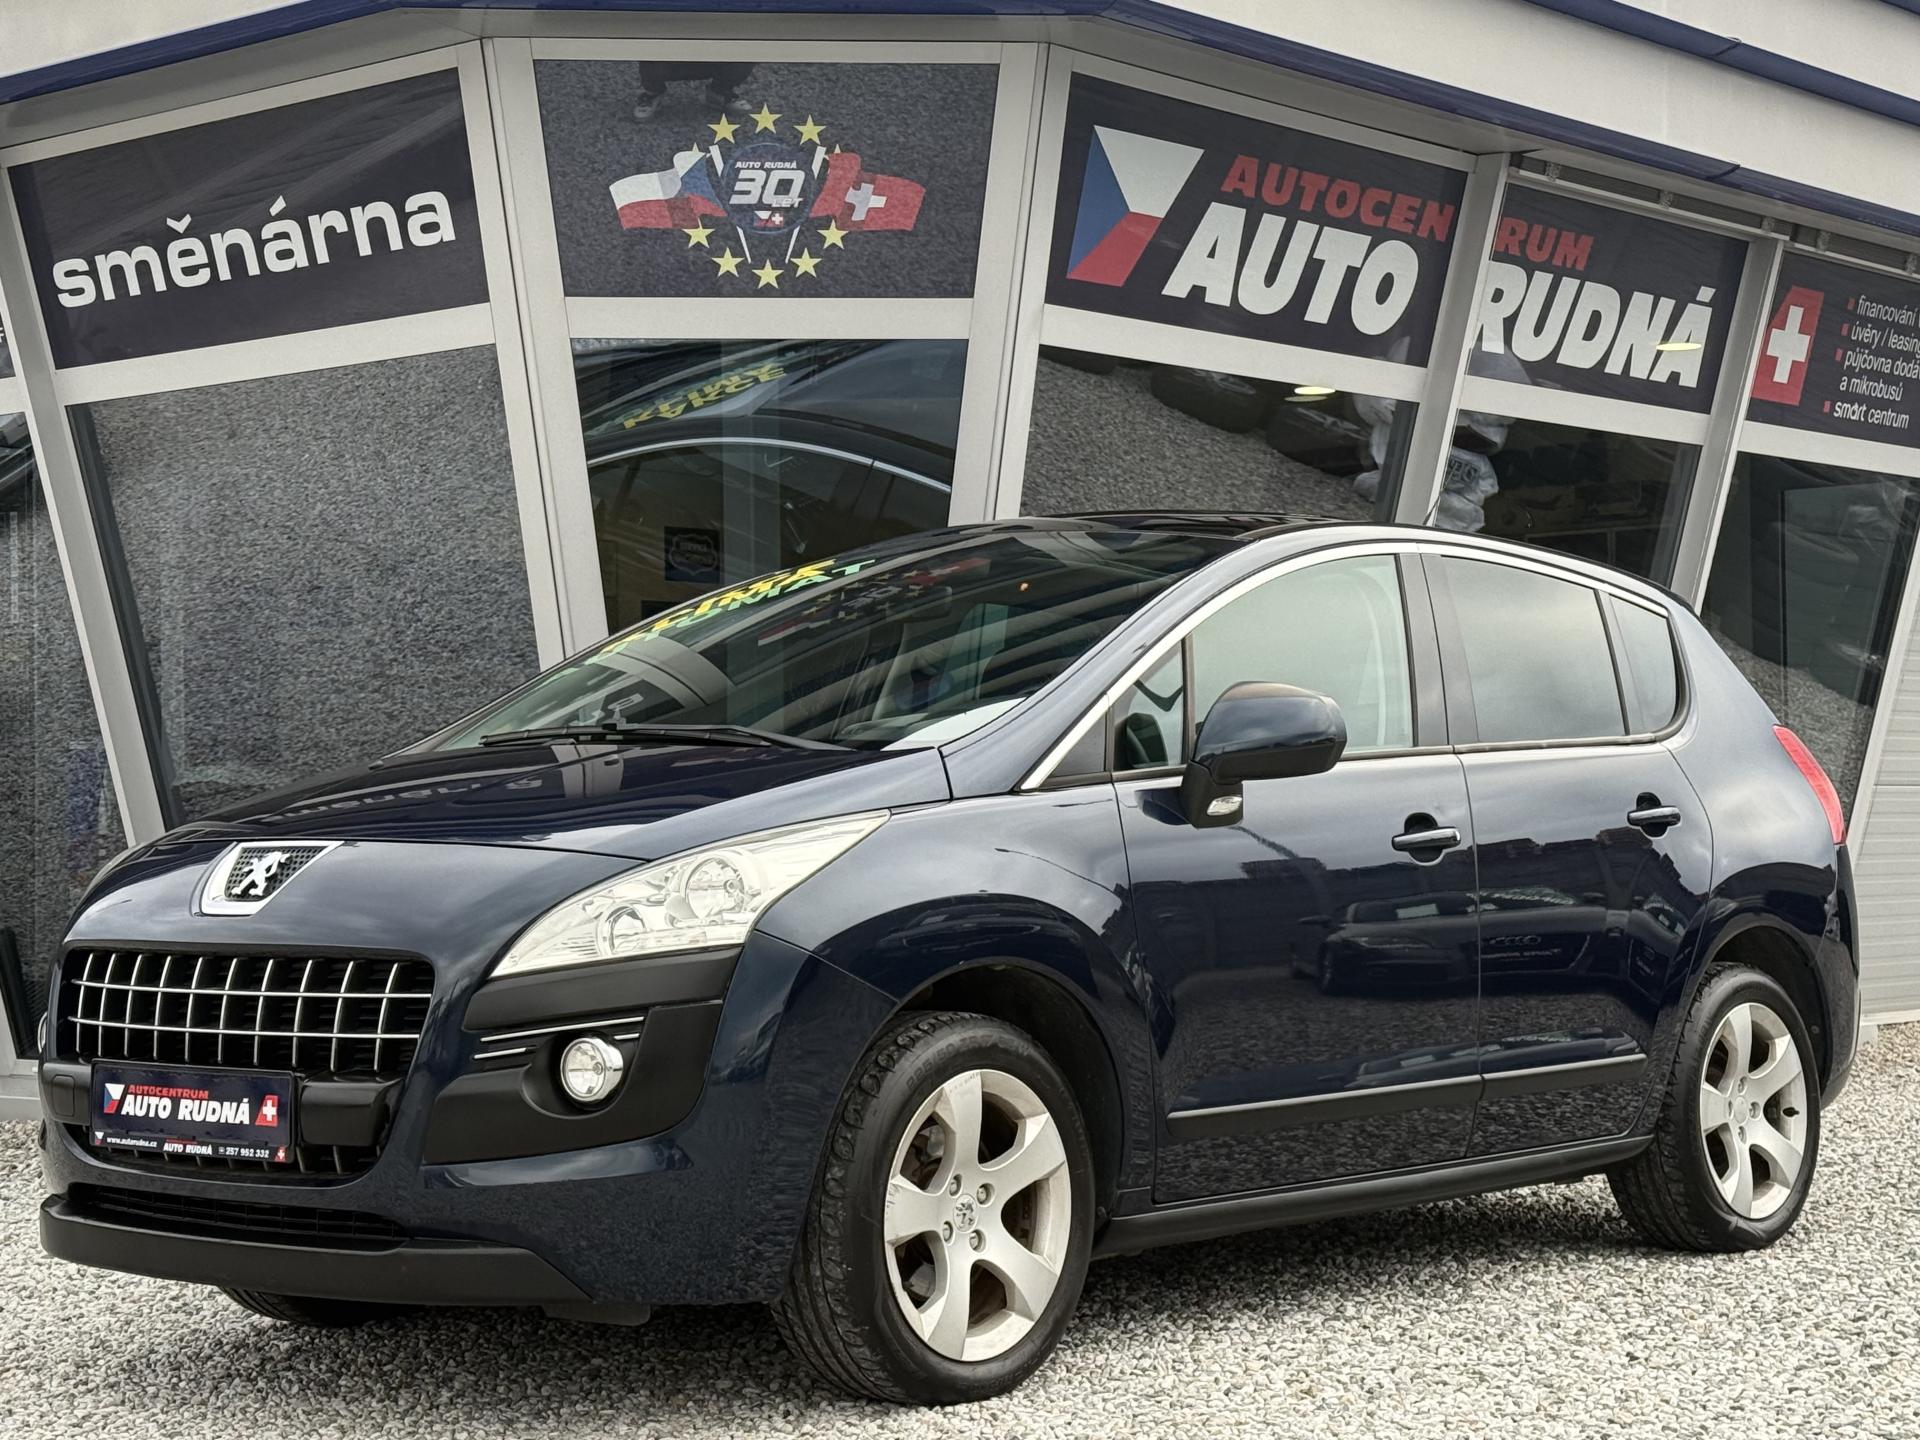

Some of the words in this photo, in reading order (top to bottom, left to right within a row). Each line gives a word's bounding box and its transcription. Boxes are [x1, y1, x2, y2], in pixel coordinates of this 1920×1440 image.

[735, 161, 761, 169] AUTO
[764, 160, 797, 169] RUDNÁ
[729, 169, 805, 205] 30
[52, 190, 456, 308] směnárna
[1161, 201, 1419, 336] AUTO
[1470, 259, 1717, 389] RUDNÁ
[1857, 294, 1919, 327] financování
[1851, 320, 1882, 350] úvěry
[1839, 376, 1848, 391] a
[1833, 401, 1867, 422] smart
[1868, 408, 1910, 429] centrum
[128, 1084, 209, 1099] AUTOCENTRUM
[121, 1094, 172, 1119] AUTO
[178, 1098, 250, 1125] RUDNÁ
[163, 1142, 184, 1152] AUTO
[185, 1144, 213, 1155] RUDNÁ
[240, 1148, 254, 1157] 952
